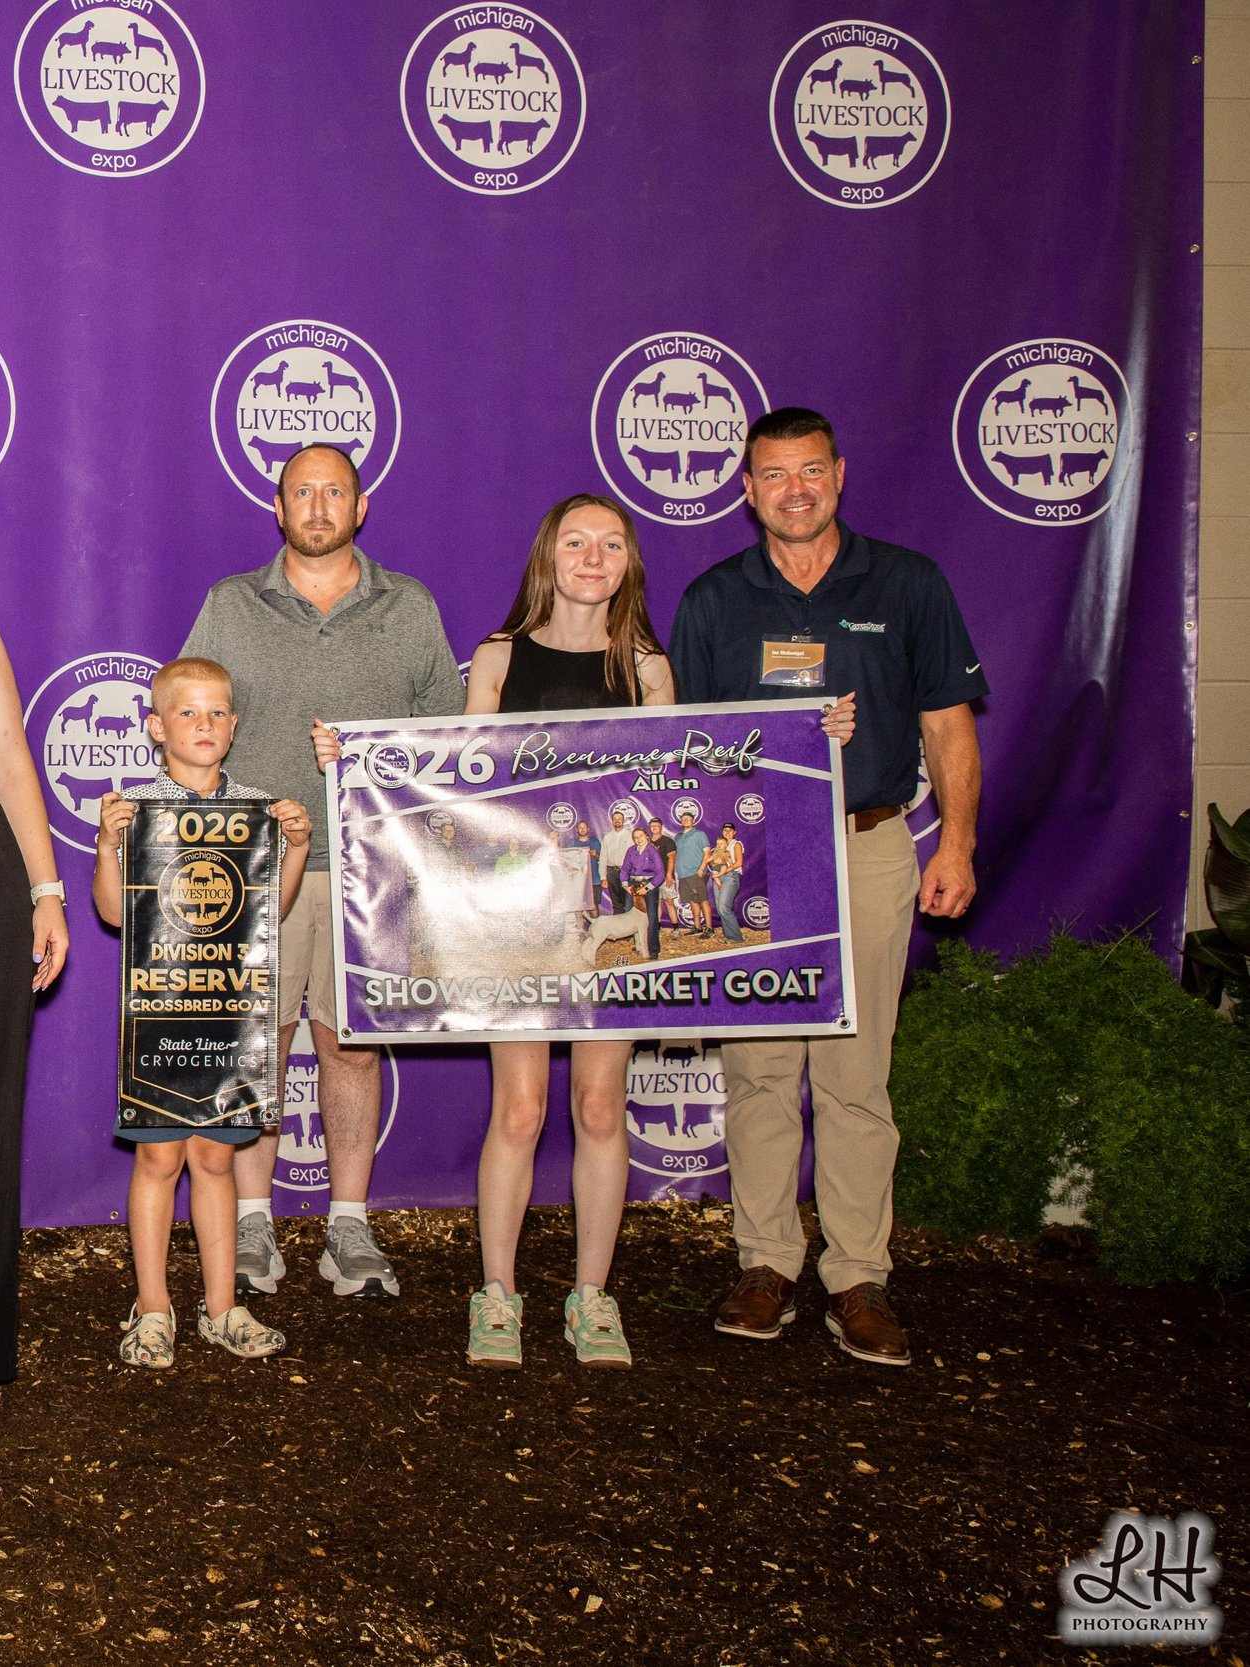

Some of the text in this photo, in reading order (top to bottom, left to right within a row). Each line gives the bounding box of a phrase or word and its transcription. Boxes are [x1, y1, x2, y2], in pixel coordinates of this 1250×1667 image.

[454, 8, 534, 33] michigan
[822, 26, 898, 50] michigan
[43, 68, 177, 95] LIVESTOCK
[430, 87, 558, 112] LIVESTOCK
[797, 104, 924, 126] LIVESTOCK
[92, 153, 136, 171] expo
[474, 172, 518, 189] expo
[841, 186, 884, 203] expo
[266, 326, 348, 351] michigan
[645, 338, 721, 363] michigan
[1006, 344, 1093, 368] michigan
[240, 408, 372, 432] LIVESTOCK
[619, 418, 744, 442] LIVESTOCK
[982, 422, 1115, 445] LIVESTOCK
[663, 503, 705, 519] expo
[1035, 504, 1081, 520] expo
[47, 744, 163, 767] LIVESTOC
[512, 731, 666, 774] Breanne
[672, 729, 764, 772] Reif
[631, 775, 699, 792] Allen
[156, 812, 250, 843] 2026
[184, 851, 222, 863] michigan
[171, 888, 231, 899] LIVESTOCK
[192, 925, 212, 935] expo
[152, 943, 231, 961] DIVISION
[131, 968, 270, 991] RESERVE
[365, 968, 823, 1007] SHOWCASE MARKET GOAT
[129, 999, 270, 1012] CROSSBRED GOAT
[159, 1038, 226, 1050] State Line
[140, 1055, 257, 1067] CRYOGENICS
[626, 1073, 728, 1093] IVESTOC
[662, 1154, 708, 1172] expo
